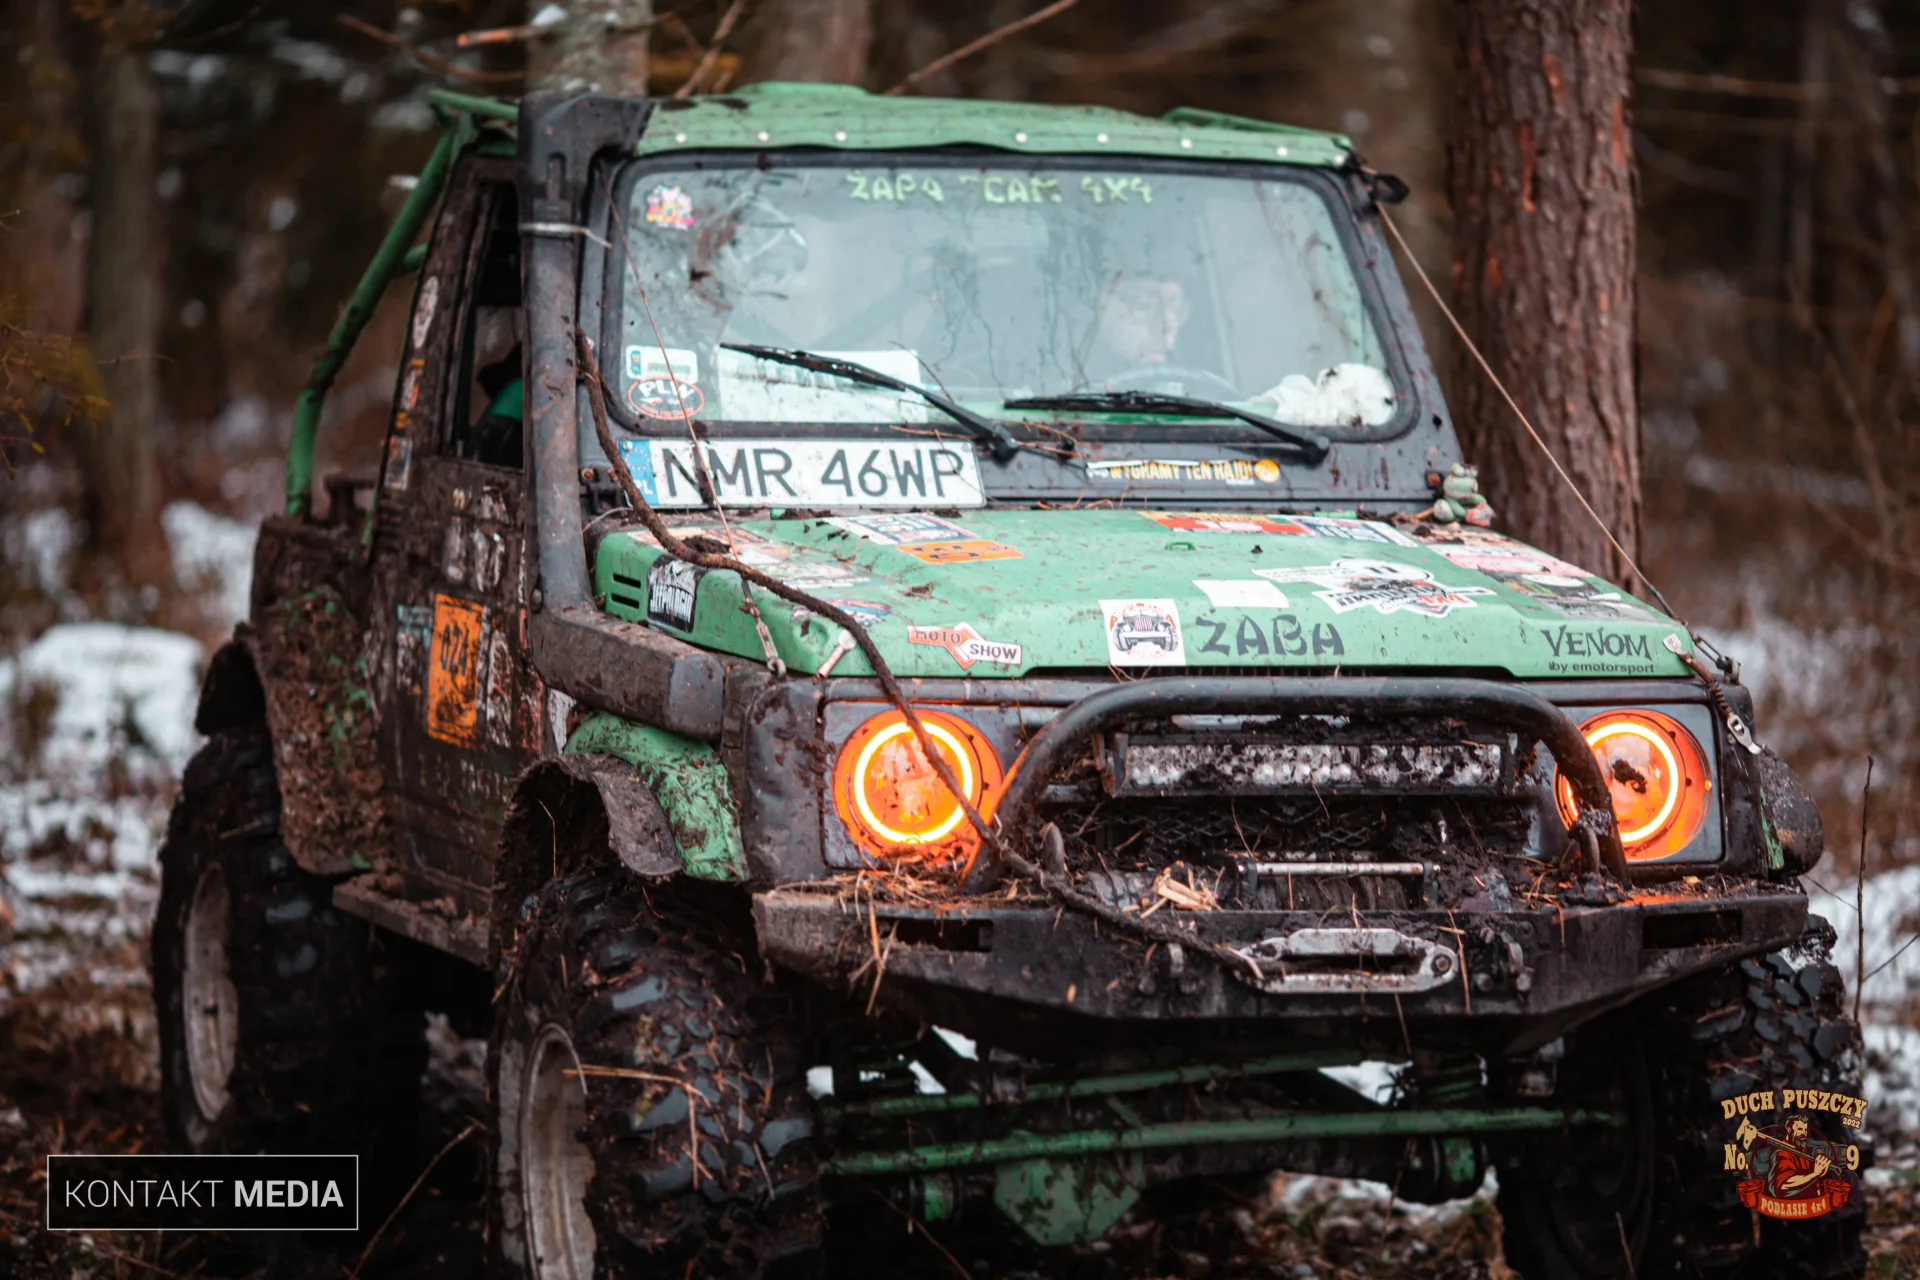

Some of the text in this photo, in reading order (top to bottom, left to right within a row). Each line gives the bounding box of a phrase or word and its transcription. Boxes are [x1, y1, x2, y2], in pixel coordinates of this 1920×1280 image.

[661, 448, 965, 498] NMR 46WP
[969, 643, 1018, 660] SHOW
[1541, 624, 1653, 661] VENOM
[1573, 663, 1655, 675] emotorsport
